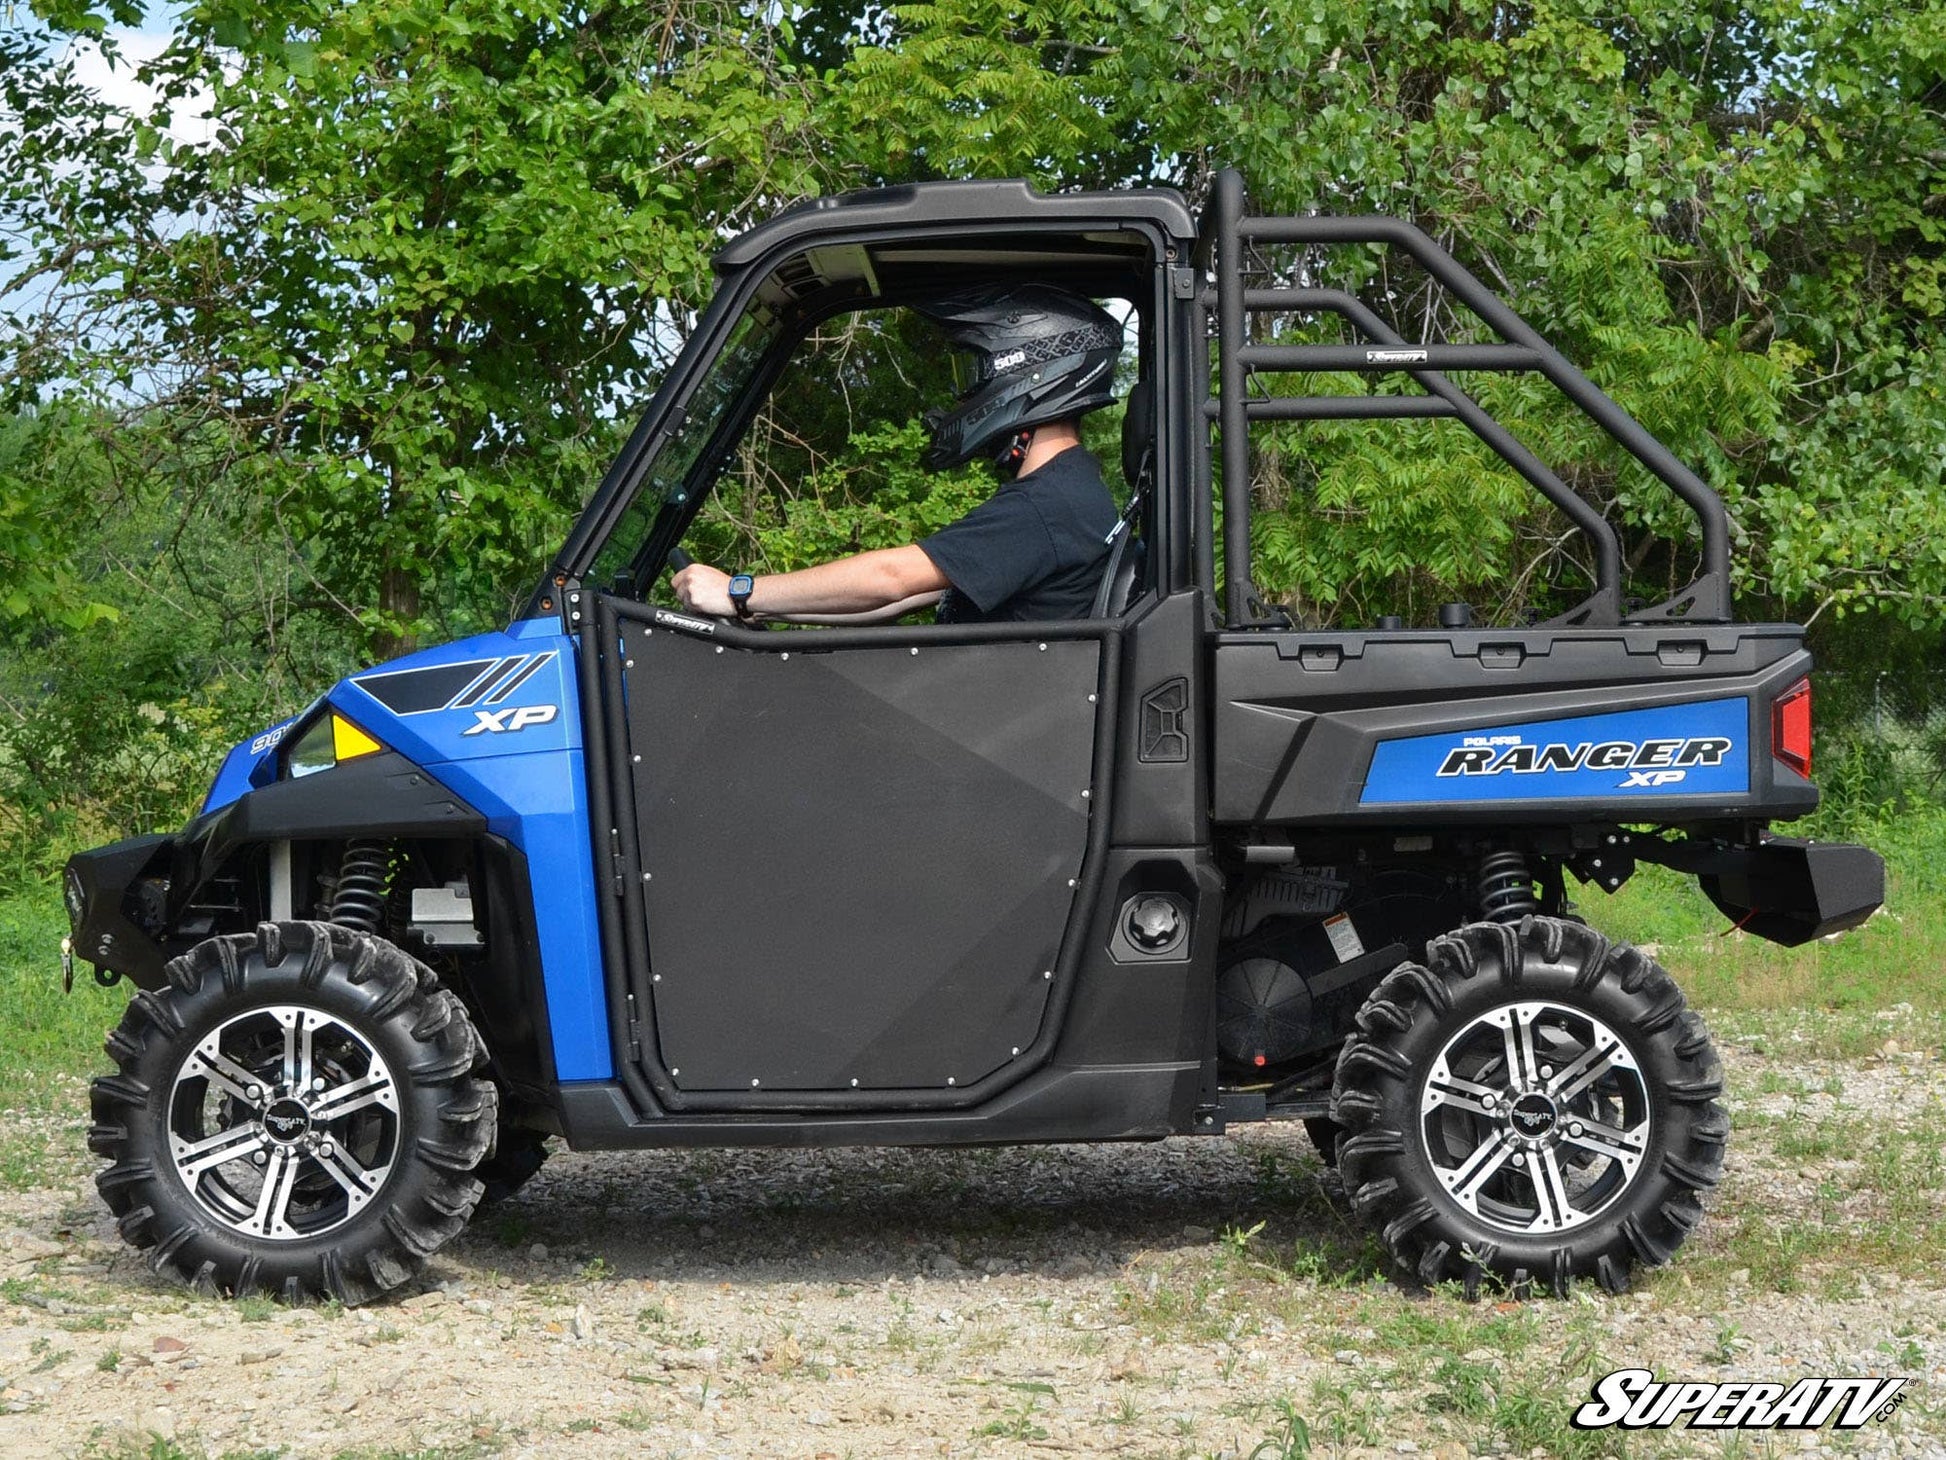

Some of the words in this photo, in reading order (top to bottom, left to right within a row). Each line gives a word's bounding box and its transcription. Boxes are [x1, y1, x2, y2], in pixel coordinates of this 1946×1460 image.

[460, 704, 559, 737] XP
[250, 722, 293, 755] 90
[1463, 735, 1522, 747] POLARIS
[1436, 737, 1732, 777] RANGER
[1614, 769, 1687, 788] XP
